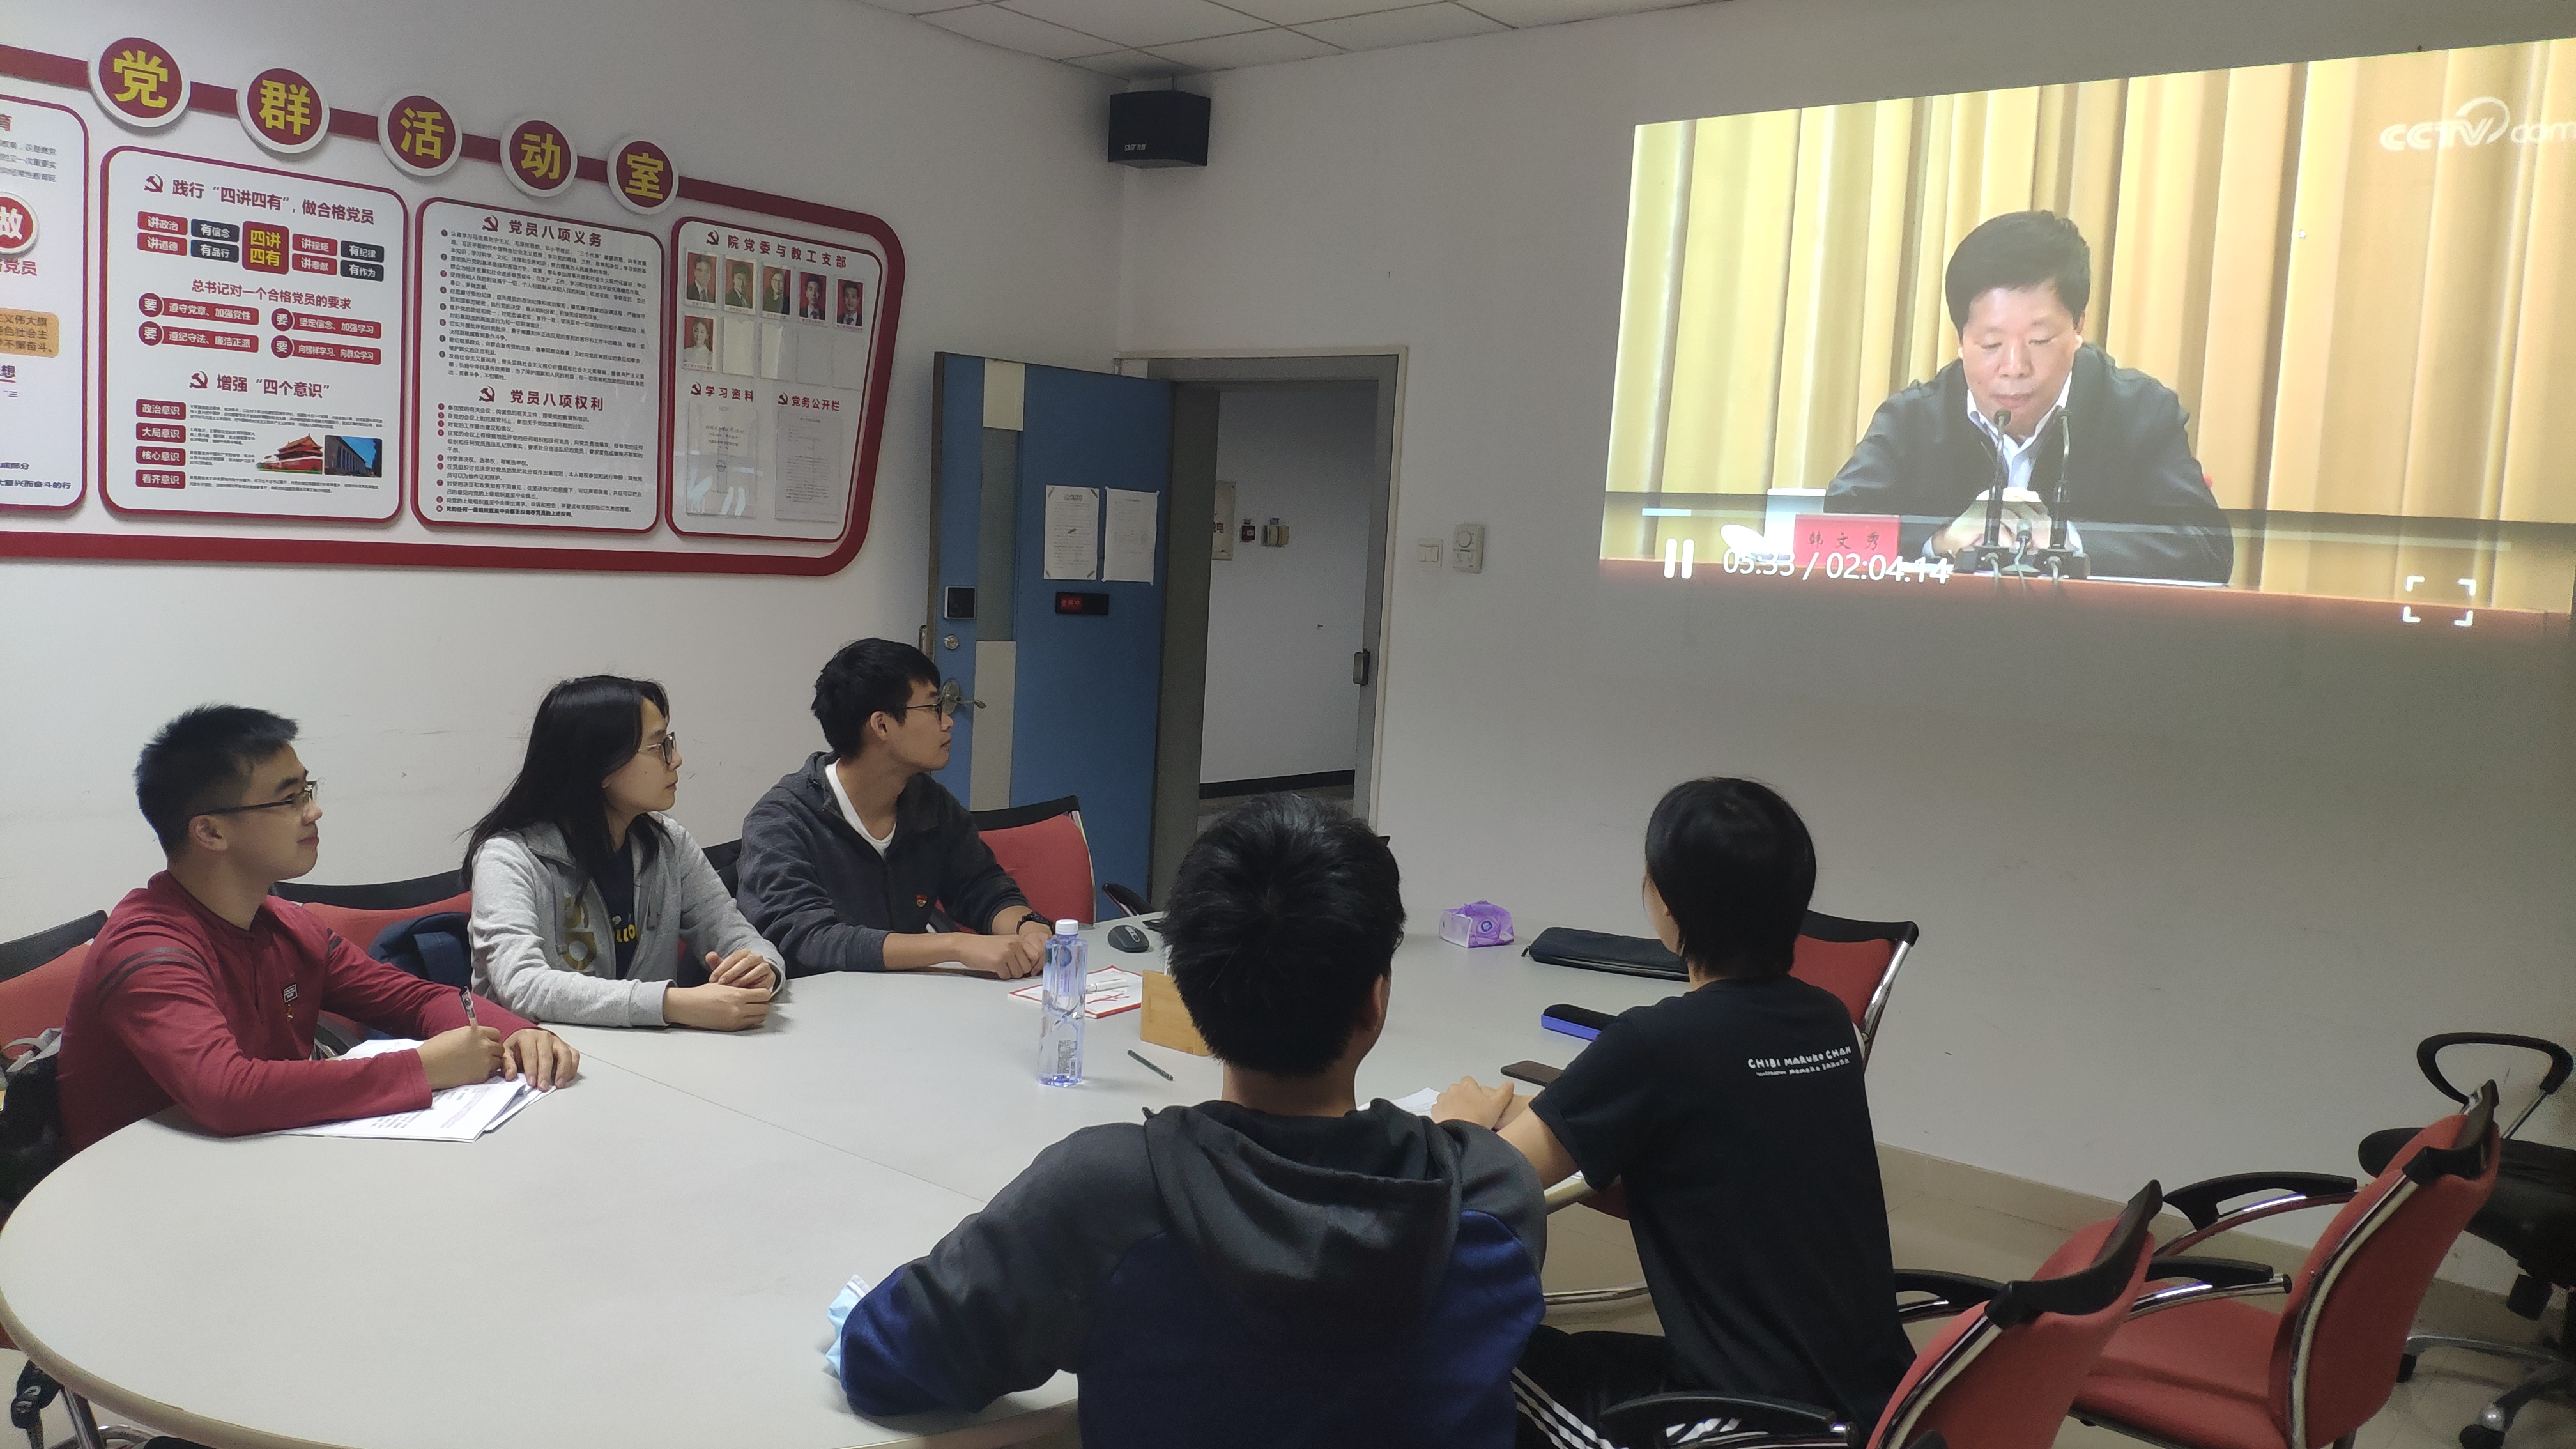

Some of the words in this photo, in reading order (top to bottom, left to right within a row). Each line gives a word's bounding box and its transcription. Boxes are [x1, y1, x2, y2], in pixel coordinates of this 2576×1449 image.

[148, 216, 178, 231] 讲政治
[200, 224, 231, 238] 有信念
[250, 229, 281, 249] 四讲
[509, 220, 601, 247] 党员八项义务
[147, 238, 178, 252] 讲道德
[200, 245, 230, 258] 有品行
[301, 238, 329, 252] 讲规矩
[349, 245, 376, 259] 有纪律
[728, 234, 847, 268] 院党委与教工支部
[250, 249, 281, 267] 四有
[301, 257, 329, 272] 讲奉献
[0, 258, 37, 276] 党员
[349, 264, 376, 278] 有作为
[191, 279, 351, 310] 总书记对一个合格党员的要求
[144, 299, 157, 311] 要
[169, 303, 251, 321] 遵守党章、加强党性
[276, 314, 288, 326] 要
[144, 327, 157, 340] 要
[276, 341, 288, 353] 要
[510, 390, 604, 411] 党员八项权利
[705, 386, 755, 402] 学习资料
[142, 404, 180, 416] 政治意识
[792, 396, 840, 411] 党务公开栏
[142, 427, 180, 439] 大局意识
[142, 450, 180, 462] 核心意识
[142, 473, 180, 486] 看齐意识
[1807, 532, 1880, 551] 韩文秀
[1723, 549, 1795, 576] 05:33
[1748, 1058, 1781, 1068] CHIBI
[1826, 1045, 1851, 1060] CHAN
